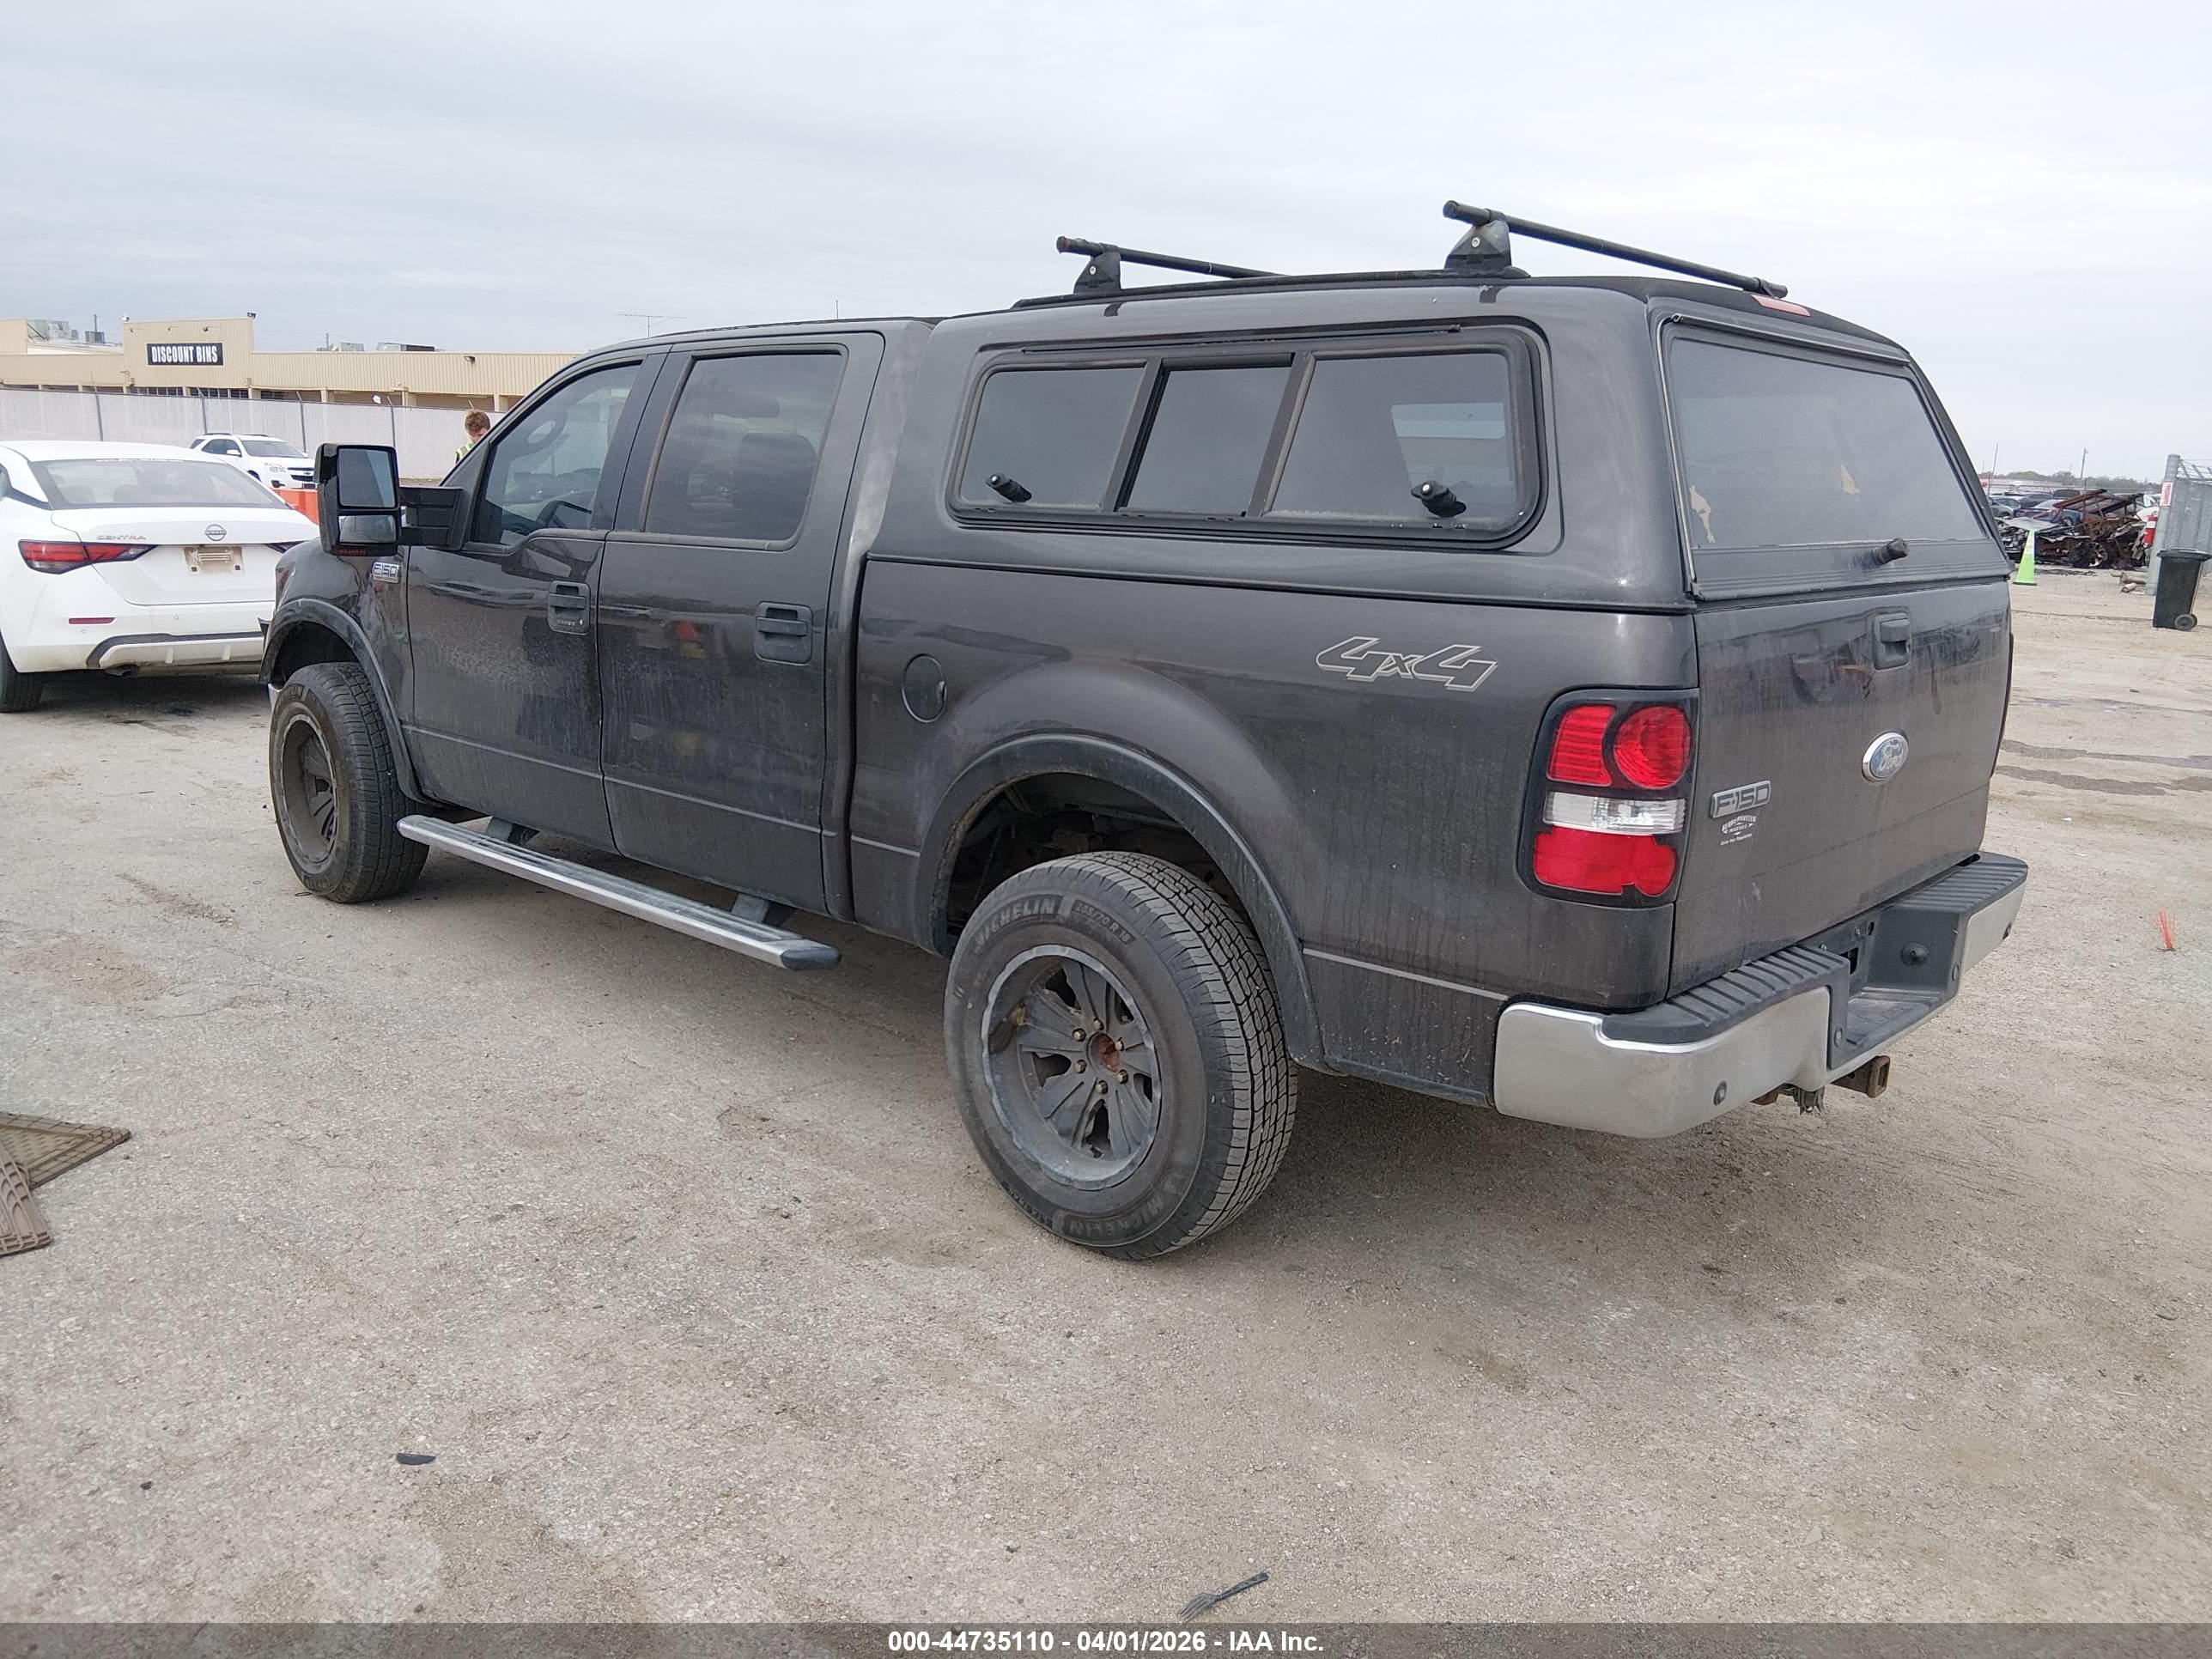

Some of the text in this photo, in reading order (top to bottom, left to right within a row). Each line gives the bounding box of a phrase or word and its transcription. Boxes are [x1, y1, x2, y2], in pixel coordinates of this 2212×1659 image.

[151, 345, 218, 363] DISCOUNT BINS
[1316, 635, 1498, 692] 4x4
